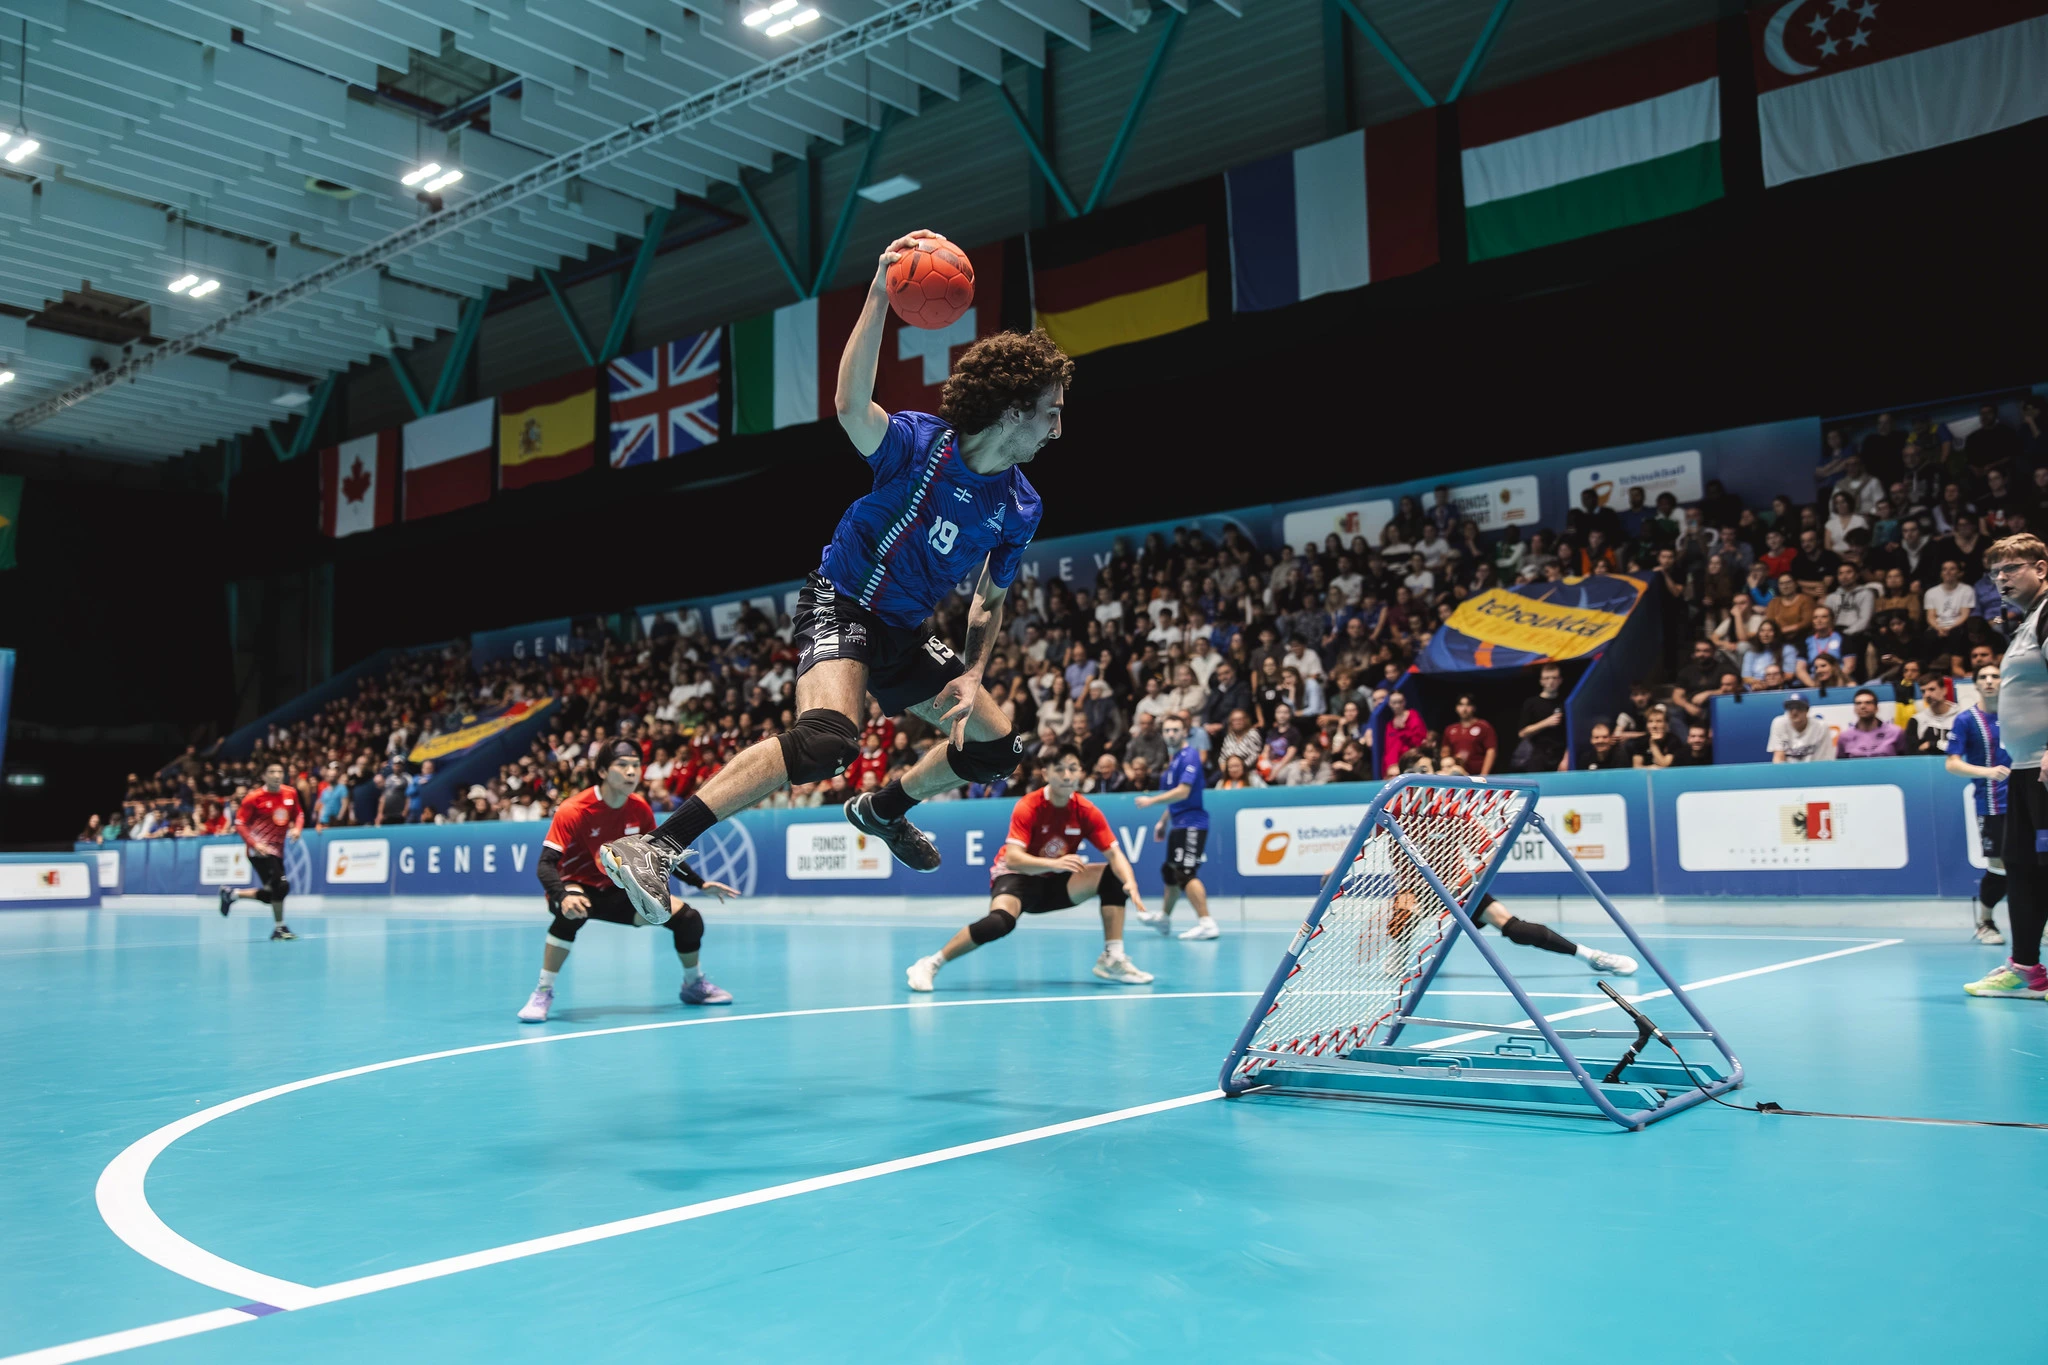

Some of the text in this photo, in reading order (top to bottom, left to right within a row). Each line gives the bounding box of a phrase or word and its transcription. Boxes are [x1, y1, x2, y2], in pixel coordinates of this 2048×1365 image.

[928, 515, 959, 555] 19
[921, 635, 955, 666] 19
[1297, 824, 1356, 840] tchoukb
[812, 836, 846, 850] FONDS
[1511, 841, 1544, 860] ORT
[400, 844, 528, 874] GENEV
[798, 855, 811, 870] DU
[814, 855, 846, 870] SPORT
